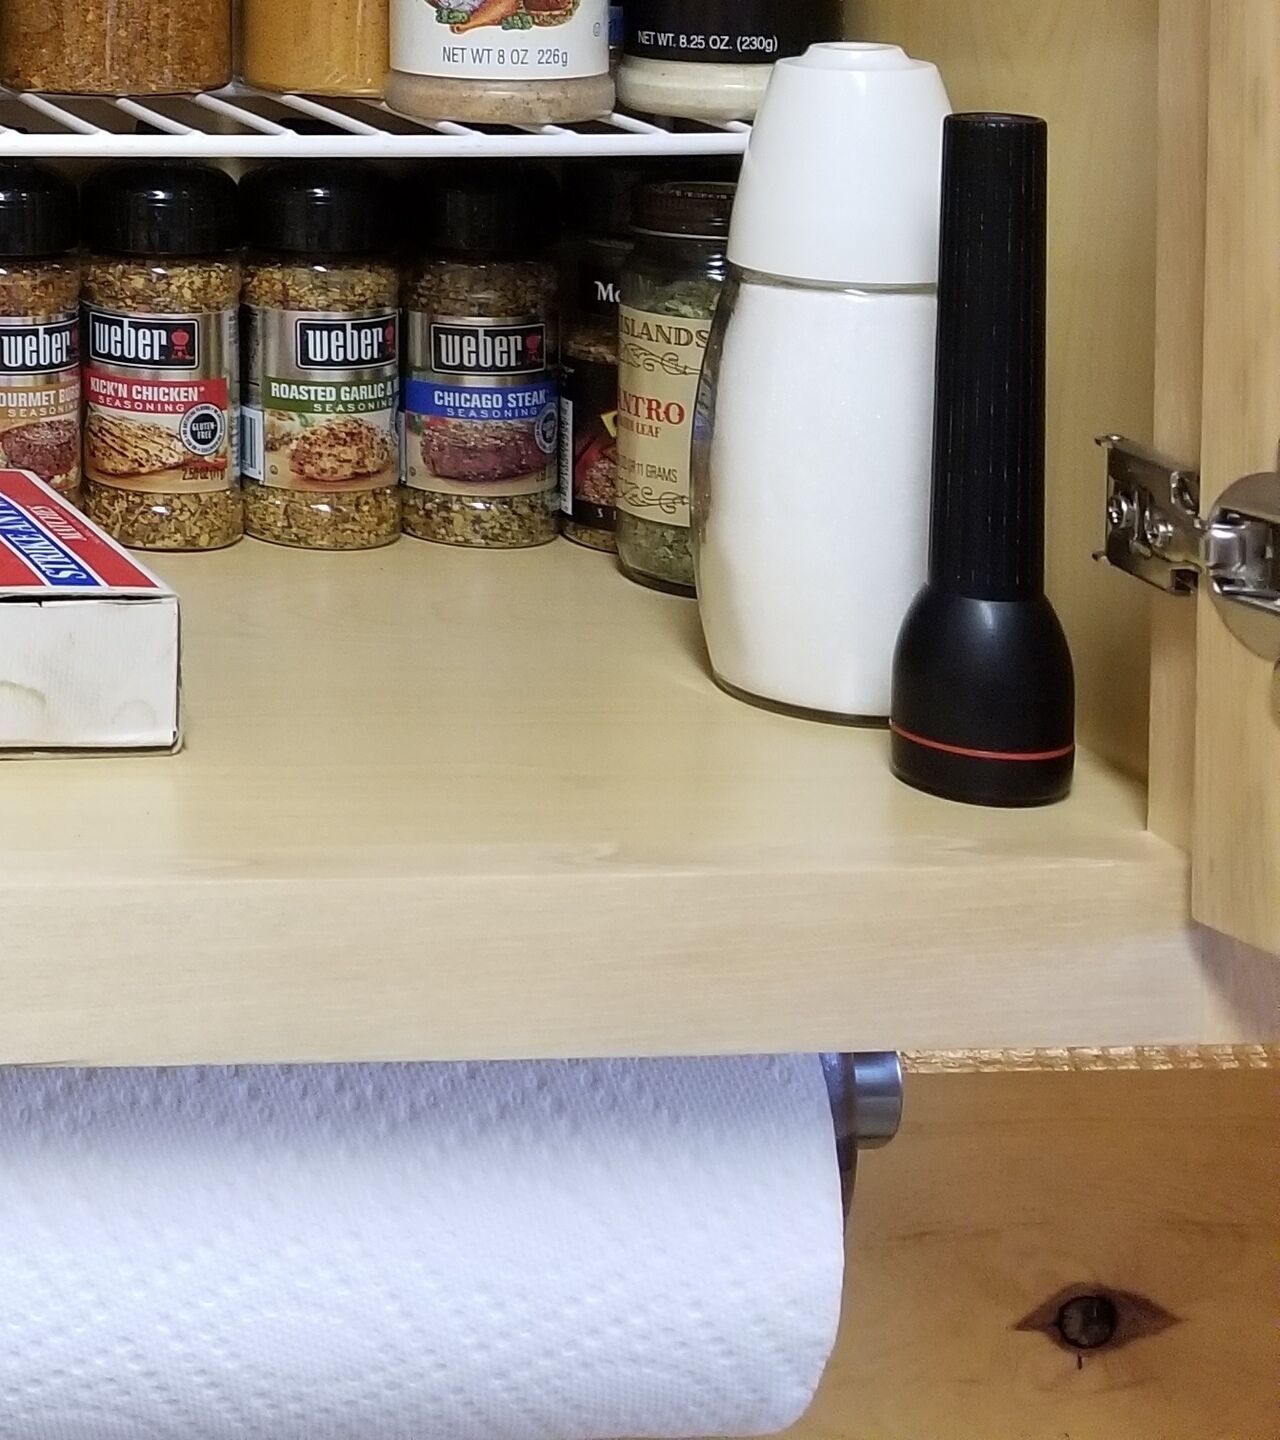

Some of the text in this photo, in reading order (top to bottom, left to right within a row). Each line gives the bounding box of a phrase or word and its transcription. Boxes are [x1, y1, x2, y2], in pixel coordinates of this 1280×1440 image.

[638, 30, 778, 52] NET WT. 8.25 OZ. (230g)
[443, 48, 568, 66] NET WT 8 OZ 226g
[1, 329, 71, 367] weber
[94, 320, 167, 361] weber
[306, 328, 383, 361] weber
[439, 329, 523, 367] weber
[132, 387, 199, 401] CHICKEN
[271, 381, 385, 401] ROASTED GARLIC
[434, 389, 546, 408] CHICAGO STEAK
[98, 396, 185, 411] SEASONING
[446, 406, 538, 418] SEASONING
[646, 464, 678, 483] GRAMS
[7, 532, 88, 579] STRIKE
